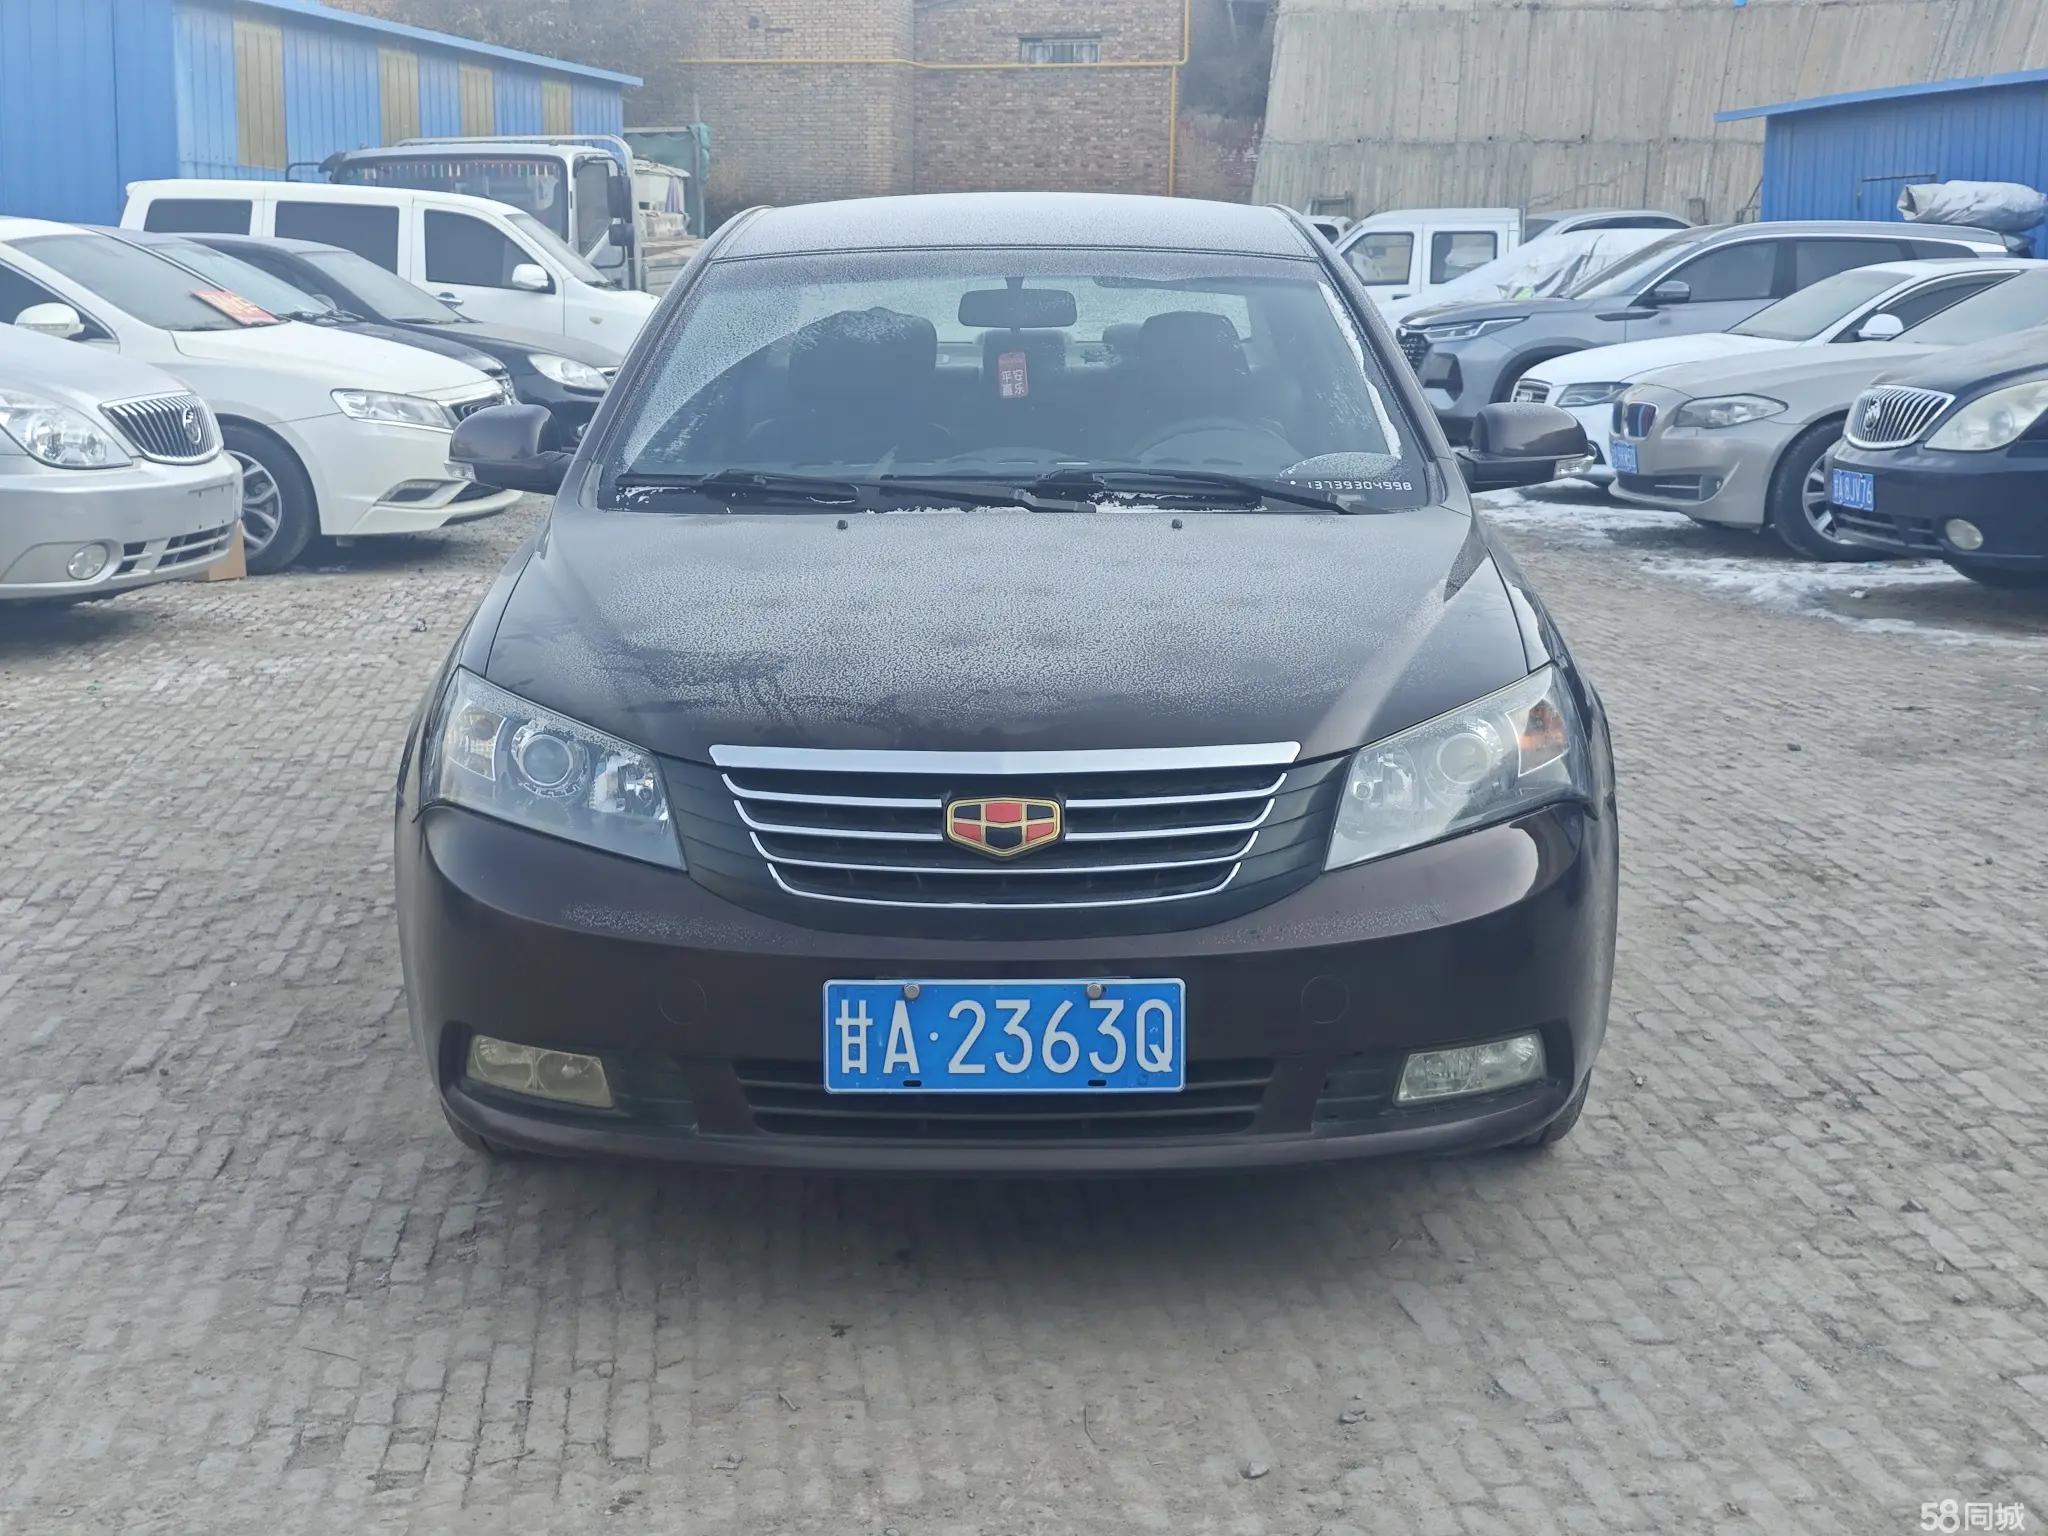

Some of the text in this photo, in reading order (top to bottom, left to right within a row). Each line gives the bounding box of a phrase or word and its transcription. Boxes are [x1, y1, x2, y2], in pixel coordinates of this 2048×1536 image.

[1001, 369, 1024, 383] 平安
[1307, 480, 1413, 491] 13739304998
[834, 998, 1174, 1075] 甘A·2363Q
